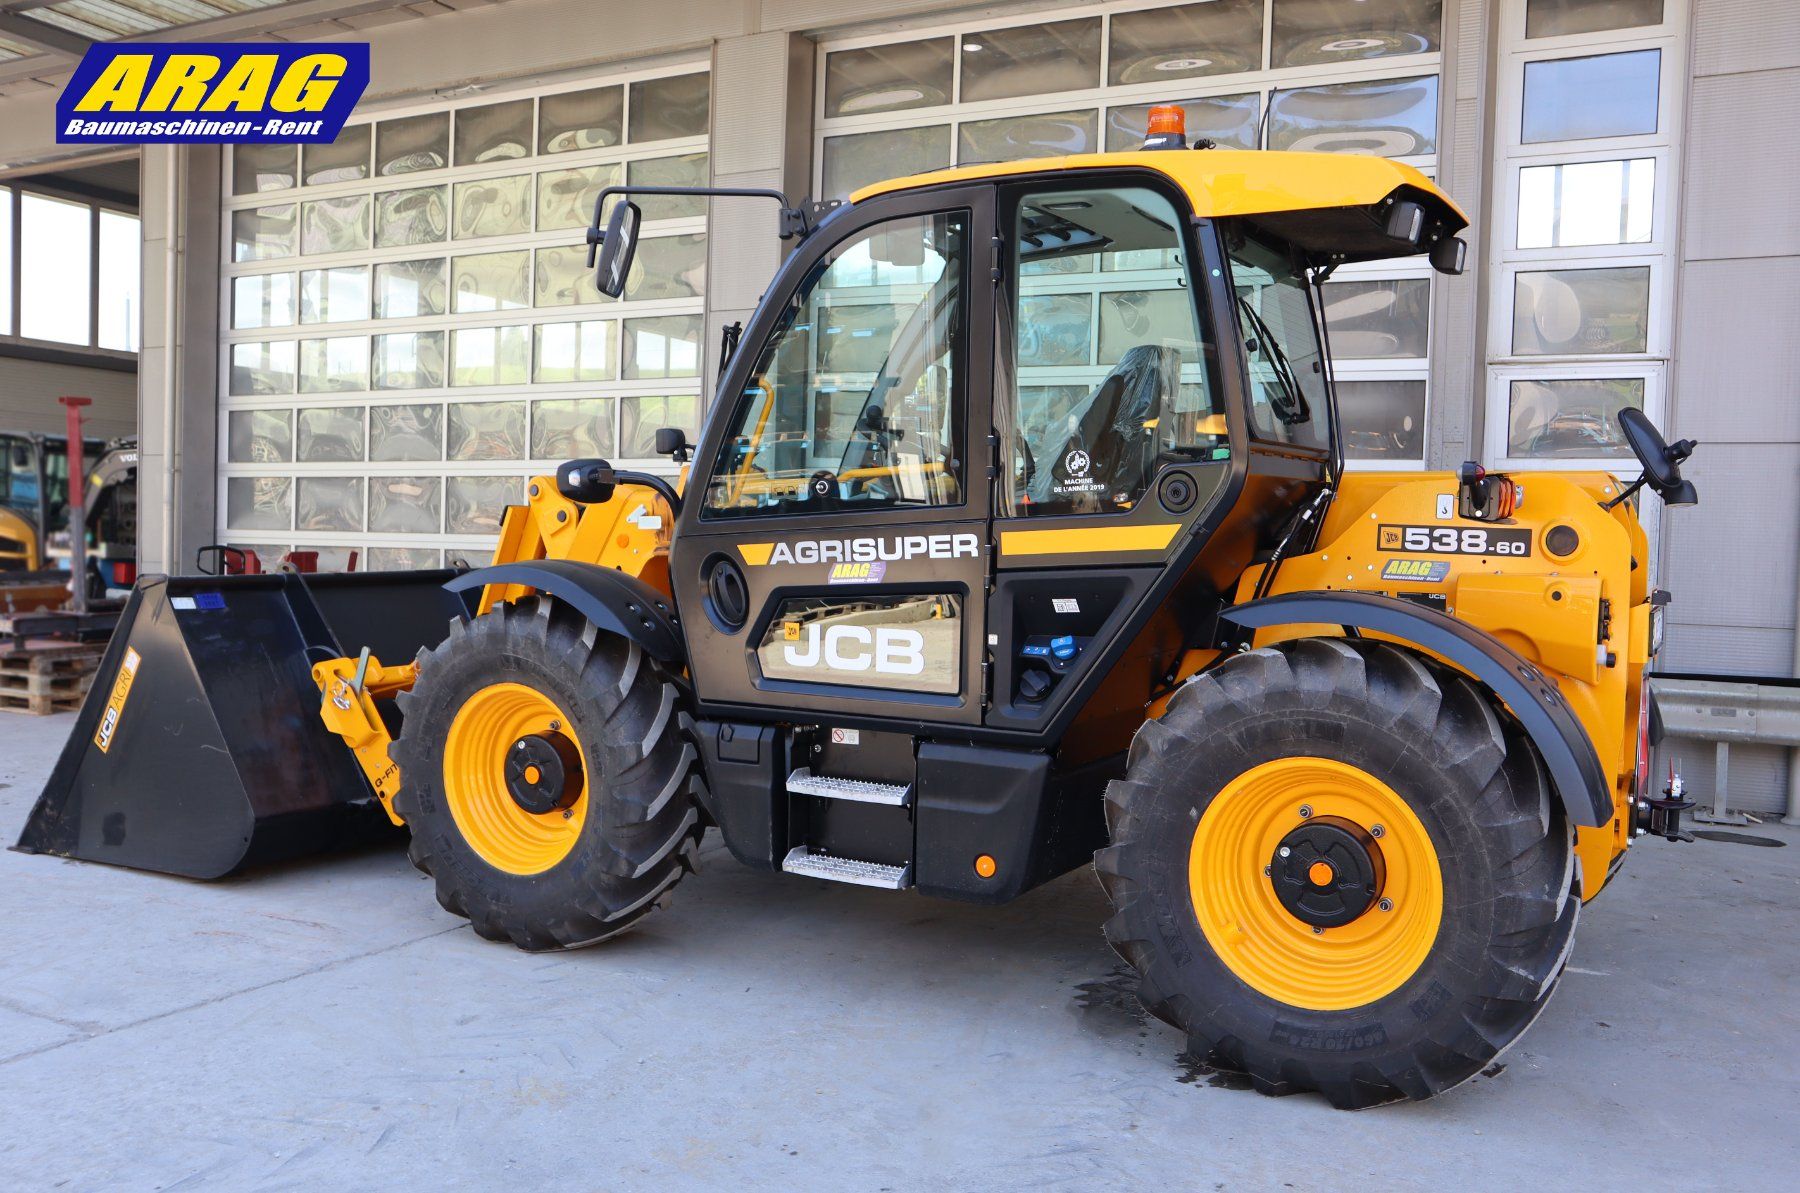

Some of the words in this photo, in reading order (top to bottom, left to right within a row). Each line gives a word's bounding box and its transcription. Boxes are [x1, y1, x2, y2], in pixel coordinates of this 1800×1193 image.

[770, 534, 980, 565] AGRISUPER
[832, 562, 871, 578] ARAG
[1385, 560, 1432, 576] ARAG
[783, 623, 925, 675] JCB
[100, 706, 117, 747] JCB
